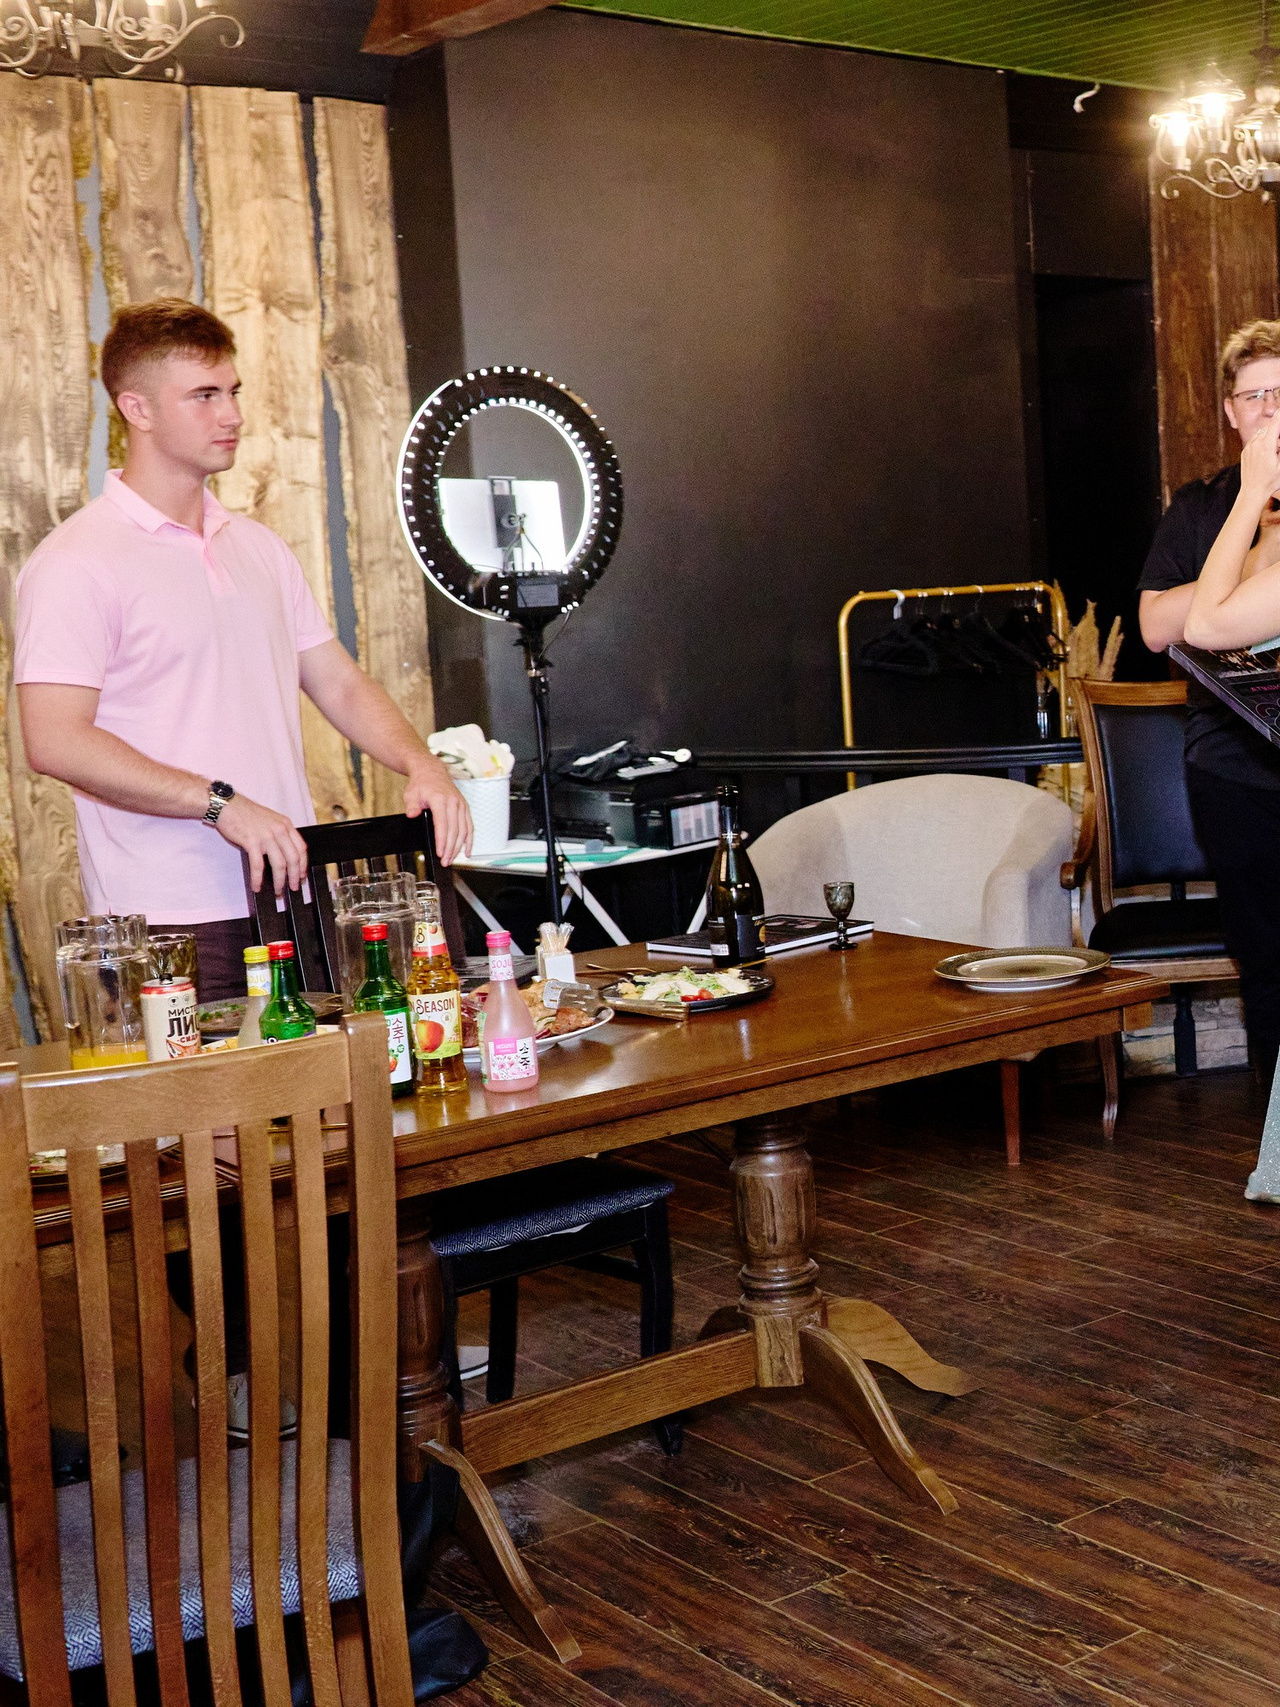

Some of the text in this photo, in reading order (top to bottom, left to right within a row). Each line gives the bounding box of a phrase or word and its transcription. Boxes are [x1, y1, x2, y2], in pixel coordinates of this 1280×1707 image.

[416, 998, 455, 1015] SEASON
[392, 1018, 404, 1044] 소주
[519, 1042, 530, 1070] 소주
